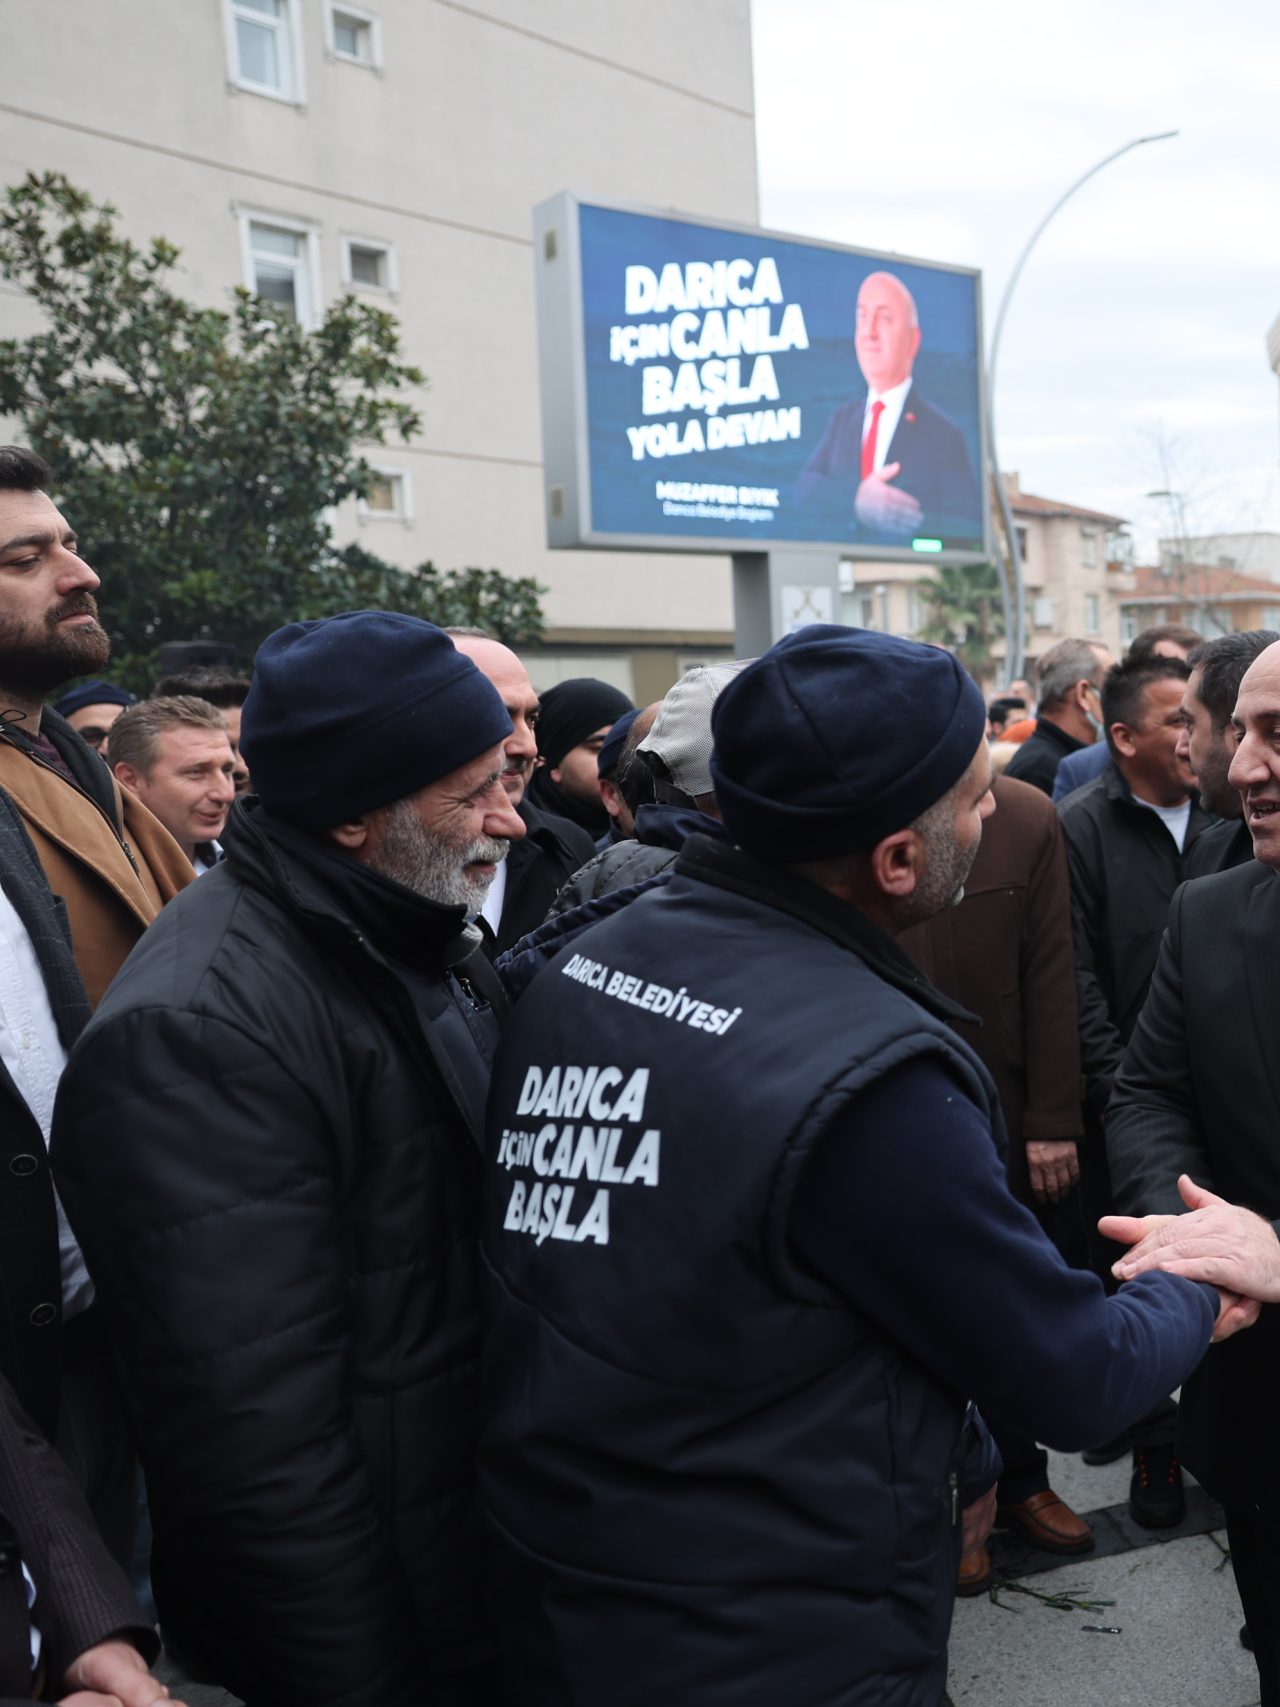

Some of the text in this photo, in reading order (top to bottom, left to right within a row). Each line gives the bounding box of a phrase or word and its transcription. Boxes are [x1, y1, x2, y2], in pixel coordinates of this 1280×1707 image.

[625, 257, 784, 315] DARICA
[610, 303, 809, 366] İÇİN CANLA
[642, 354, 780, 416] BAŞLA
[626, 406, 801, 460] YOLA DEVAM
[562, 954, 743, 1035] DARICA BELEDİYESİ
[516, 1065, 650, 1122] DARICA
[496, 1123, 660, 1186] İÇİN CANLA
[503, 1180, 610, 1246] BAŞLA
